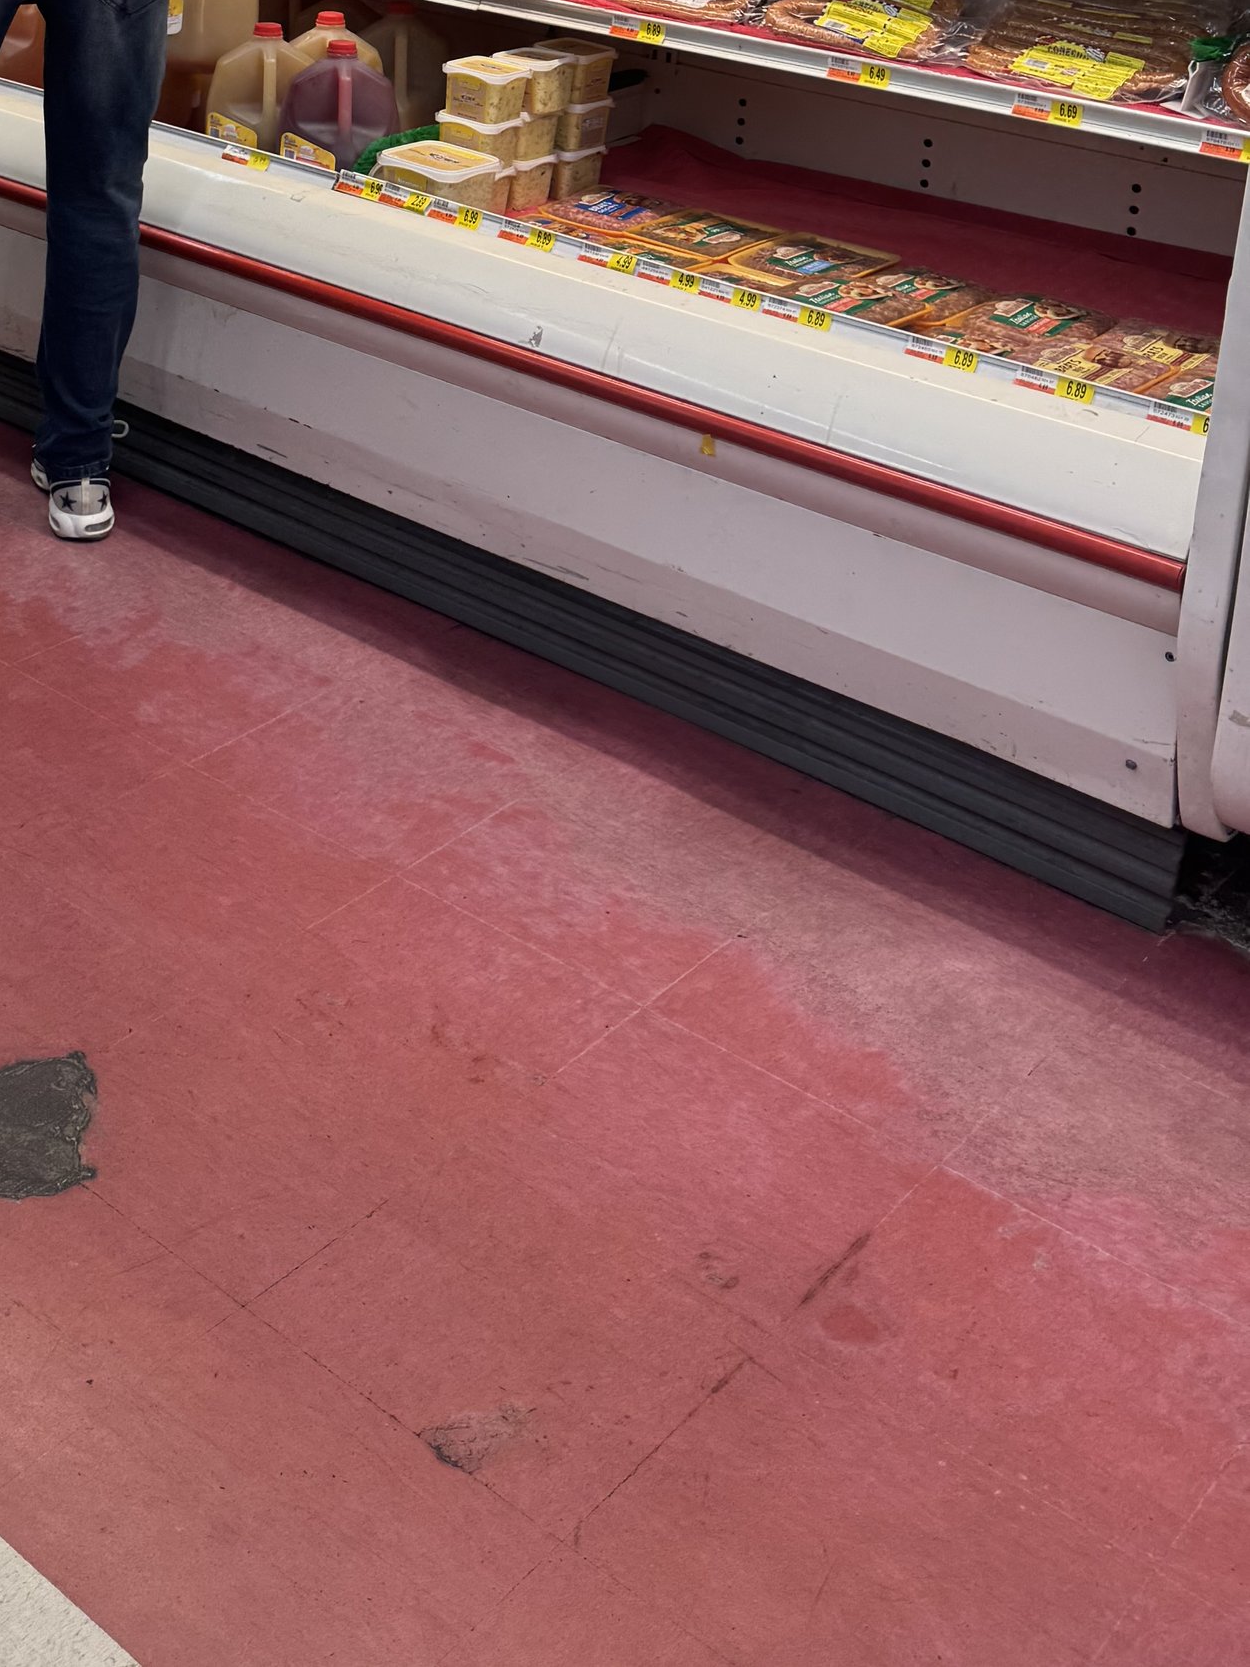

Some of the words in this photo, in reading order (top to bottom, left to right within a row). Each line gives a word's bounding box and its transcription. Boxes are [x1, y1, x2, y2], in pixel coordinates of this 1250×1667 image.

[646, 23, 661, 37] 6.89
[869, 66, 886, 81] 6.49
[1059, 103, 1078, 119] 6.69
[463, 210, 479, 224] 6.99
[536, 231, 552, 245] 6.89
[616, 255, 633, 269] 4.99
[678, 272, 695, 287] 4.99
[739, 291, 757, 308] 4.99
[807, 309, 826, 327] 6.89
[954, 350, 975, 368] 6.89
[1066, 380, 1087, 399] 6.89
